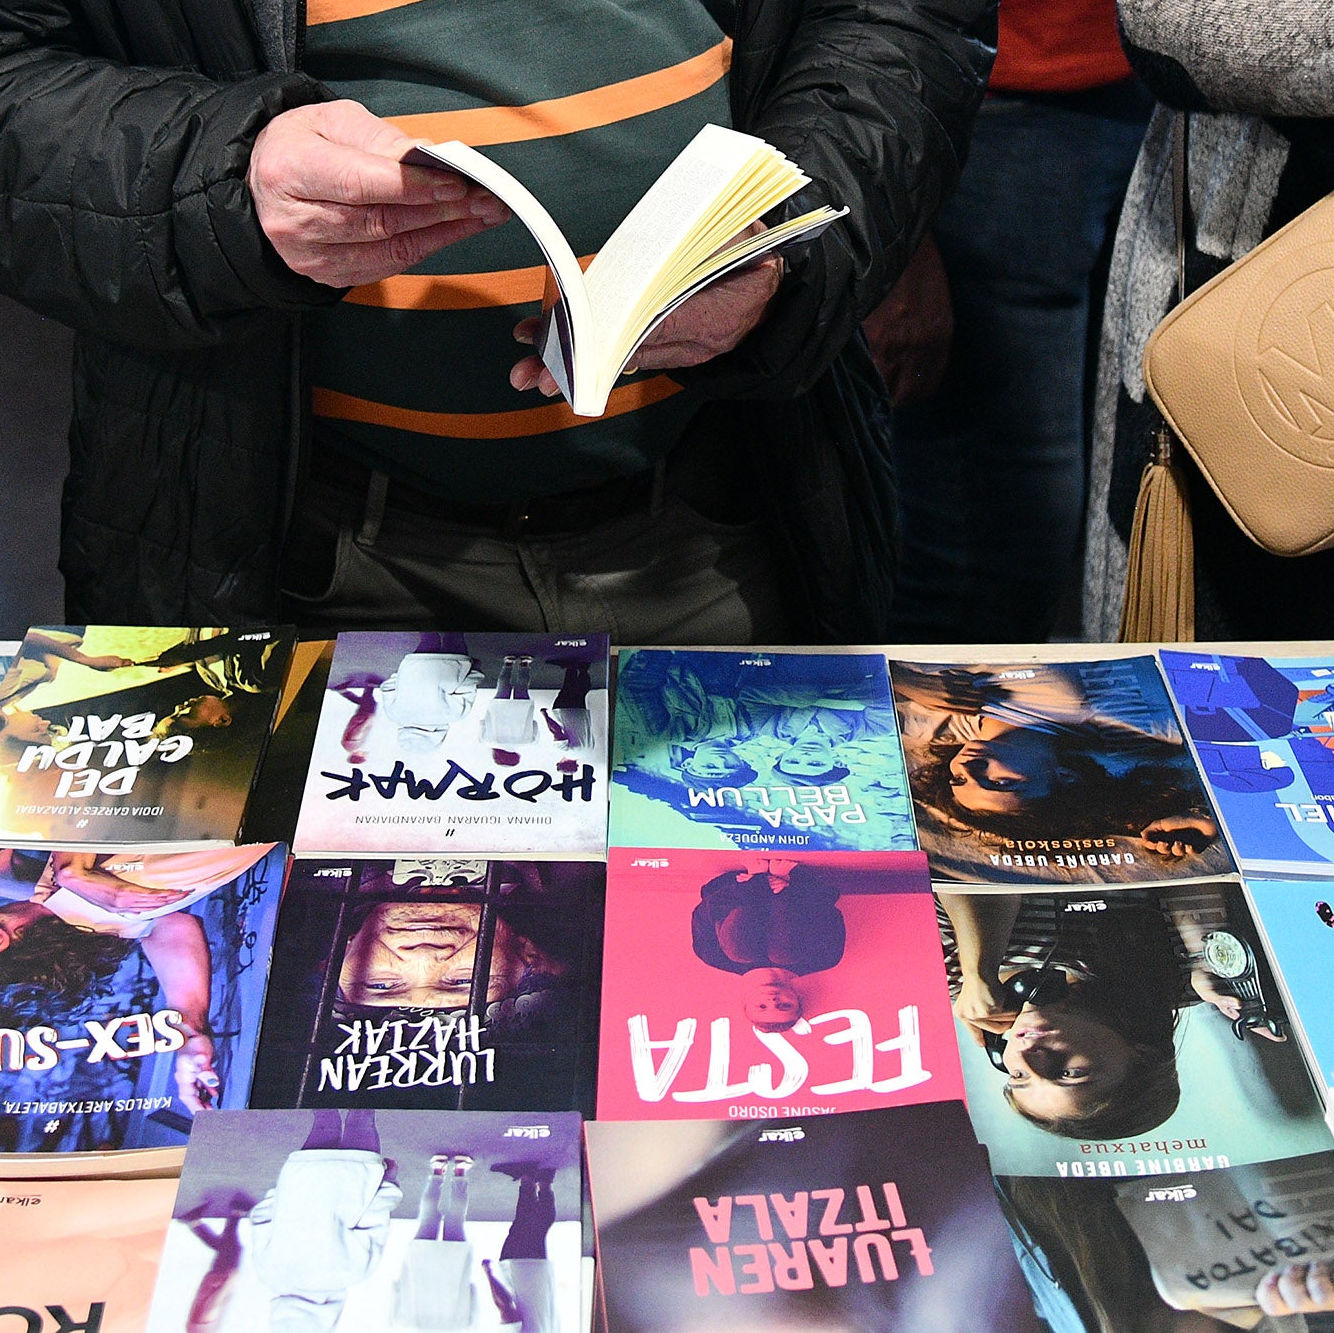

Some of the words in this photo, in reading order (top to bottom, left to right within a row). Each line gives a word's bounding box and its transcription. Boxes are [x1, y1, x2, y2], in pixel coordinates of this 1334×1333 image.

[238, 632, 271, 643] elkar
[555, 639, 587, 648] elkar
[739, 659, 772, 668] elkar
[1190, 663, 1220, 672] elkar
[999, 671, 1035, 681] elkar
[60, 711, 156, 742] BAT
[18, 732, 194, 772] GALDU
[57, 765, 138, 799] DEI
[321, 760, 596, 804] HORMAK
[687, 784, 852, 808] BELLUM
[84, 805, 129, 816] GARZES
[132, 806, 164, 816] IDOIA
[758, 802, 866, 828] PARA
[355, 815, 441, 826] BARANDIARAN
[447, 815, 501, 826] IGUARAN
[719, 833, 776, 844] ANDUEZA
[779, 835, 810, 845] JOHN
[1004, 838, 1116, 854] sasieskola
[106, 861, 144, 873] elkar
[631, 858, 669, 869] elkar
[989, 853, 1048, 867] UBEDA
[1054, 851, 1134, 869] GARBIÑE
[313, 867, 352, 879] elkar
[1064, 901, 1107, 914] elkar
[333, 1014, 487, 1055] HAZIAK
[626, 1003, 932, 1104] FESTA
[317, 1047, 495, 1092] LURREAN
[3, 1100, 112, 1115] ARETXABALETA,
[116, 1095, 172, 1111] KARLOS
[504, 1126, 550, 1139] elkar
[759, 1127, 805, 1144] elkar
[1079, 1137, 1207, 1157] mehatxua
[1056, 1158, 1127, 1177] UBEDA
[1145, 1185, 1197, 1203] elkar
[693, 1181, 907, 1242] ITZALA
